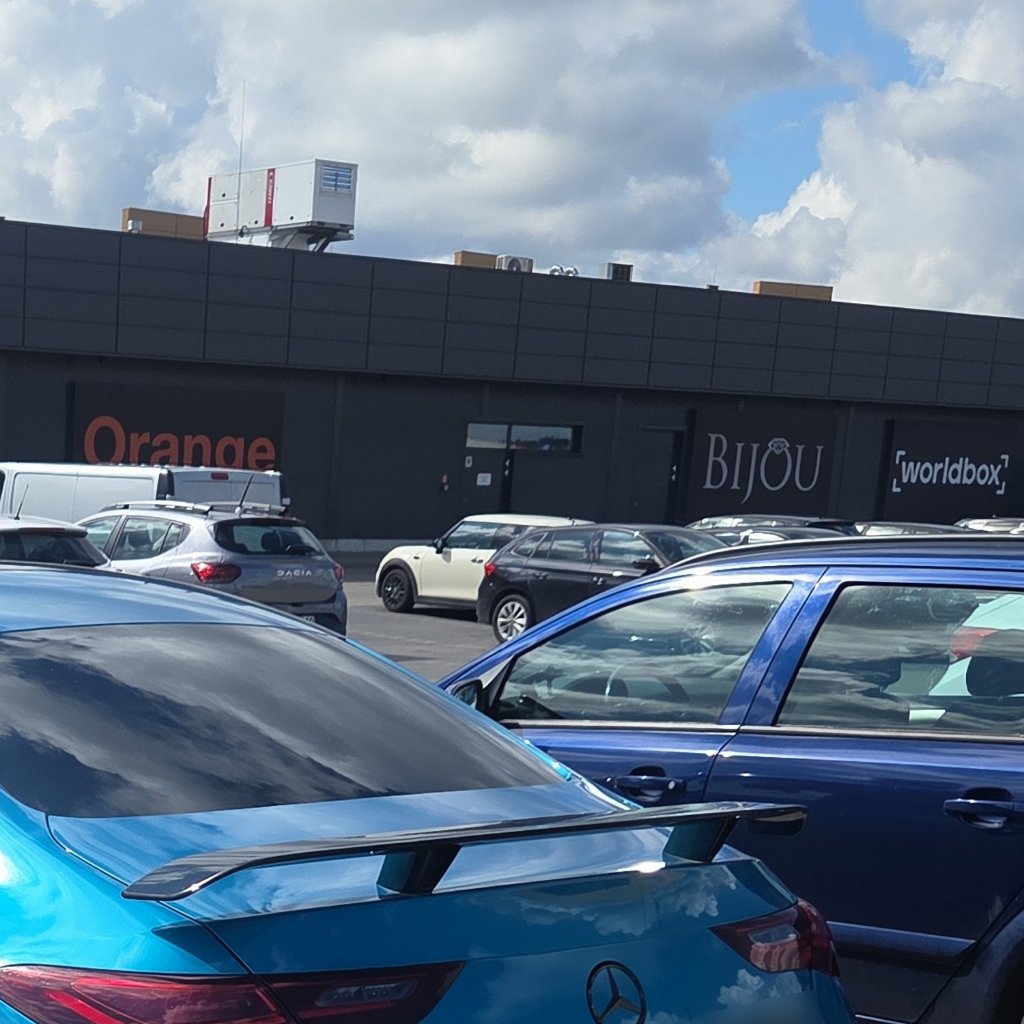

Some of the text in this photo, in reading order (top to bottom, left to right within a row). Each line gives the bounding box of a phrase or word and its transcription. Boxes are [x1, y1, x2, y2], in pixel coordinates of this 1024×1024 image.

[83, 415, 276, 471] Orange
[702, 432, 825, 505] BIJOU
[901, 456, 1003, 485] worldbox
[276, 569, 312, 577] DACIA
